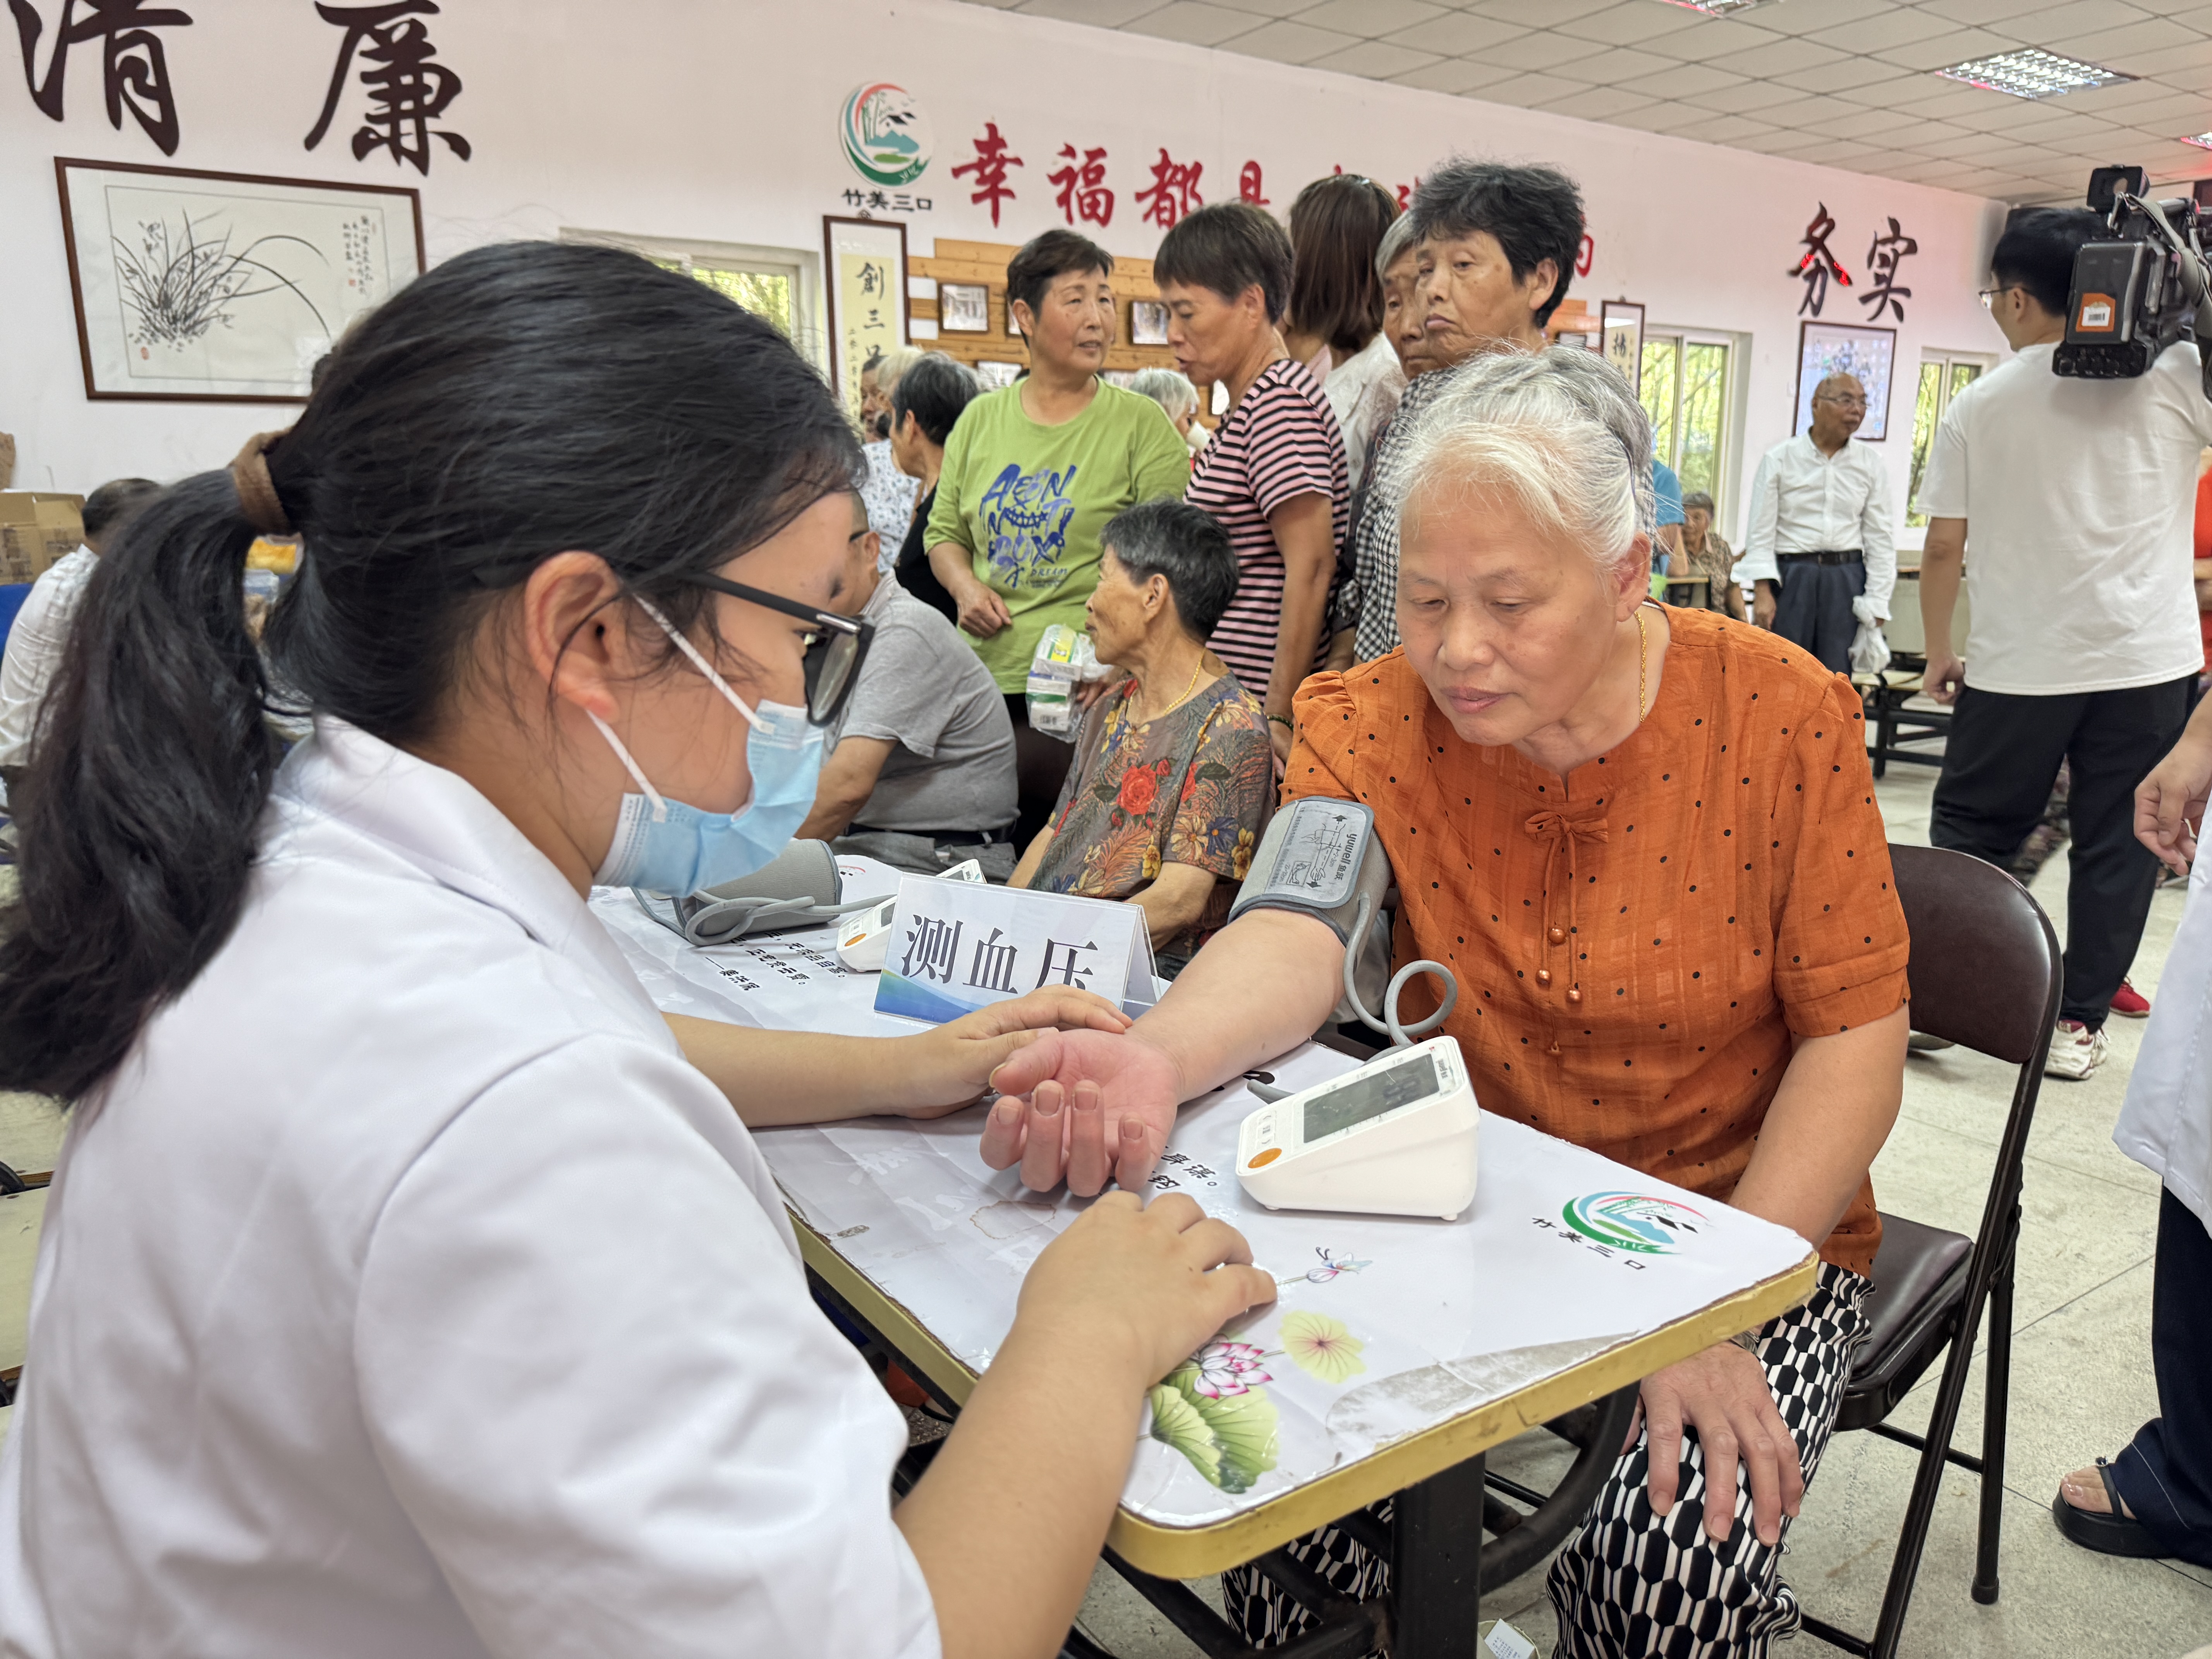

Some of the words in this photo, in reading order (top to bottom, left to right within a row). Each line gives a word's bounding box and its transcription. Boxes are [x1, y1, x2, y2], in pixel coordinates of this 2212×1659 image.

[841, 188, 932, 213] 竹美三口
[1787, 200, 1918, 323] 务实
[1340, 833, 1357, 864] yuwell
[902, 914, 1098, 994] 测血压
[1147, 1170, 1181, 1189] 钩
[1161, 1146, 1217, 1186] 身谋。
[1532, 1217, 1646, 1269] 竹美三口
